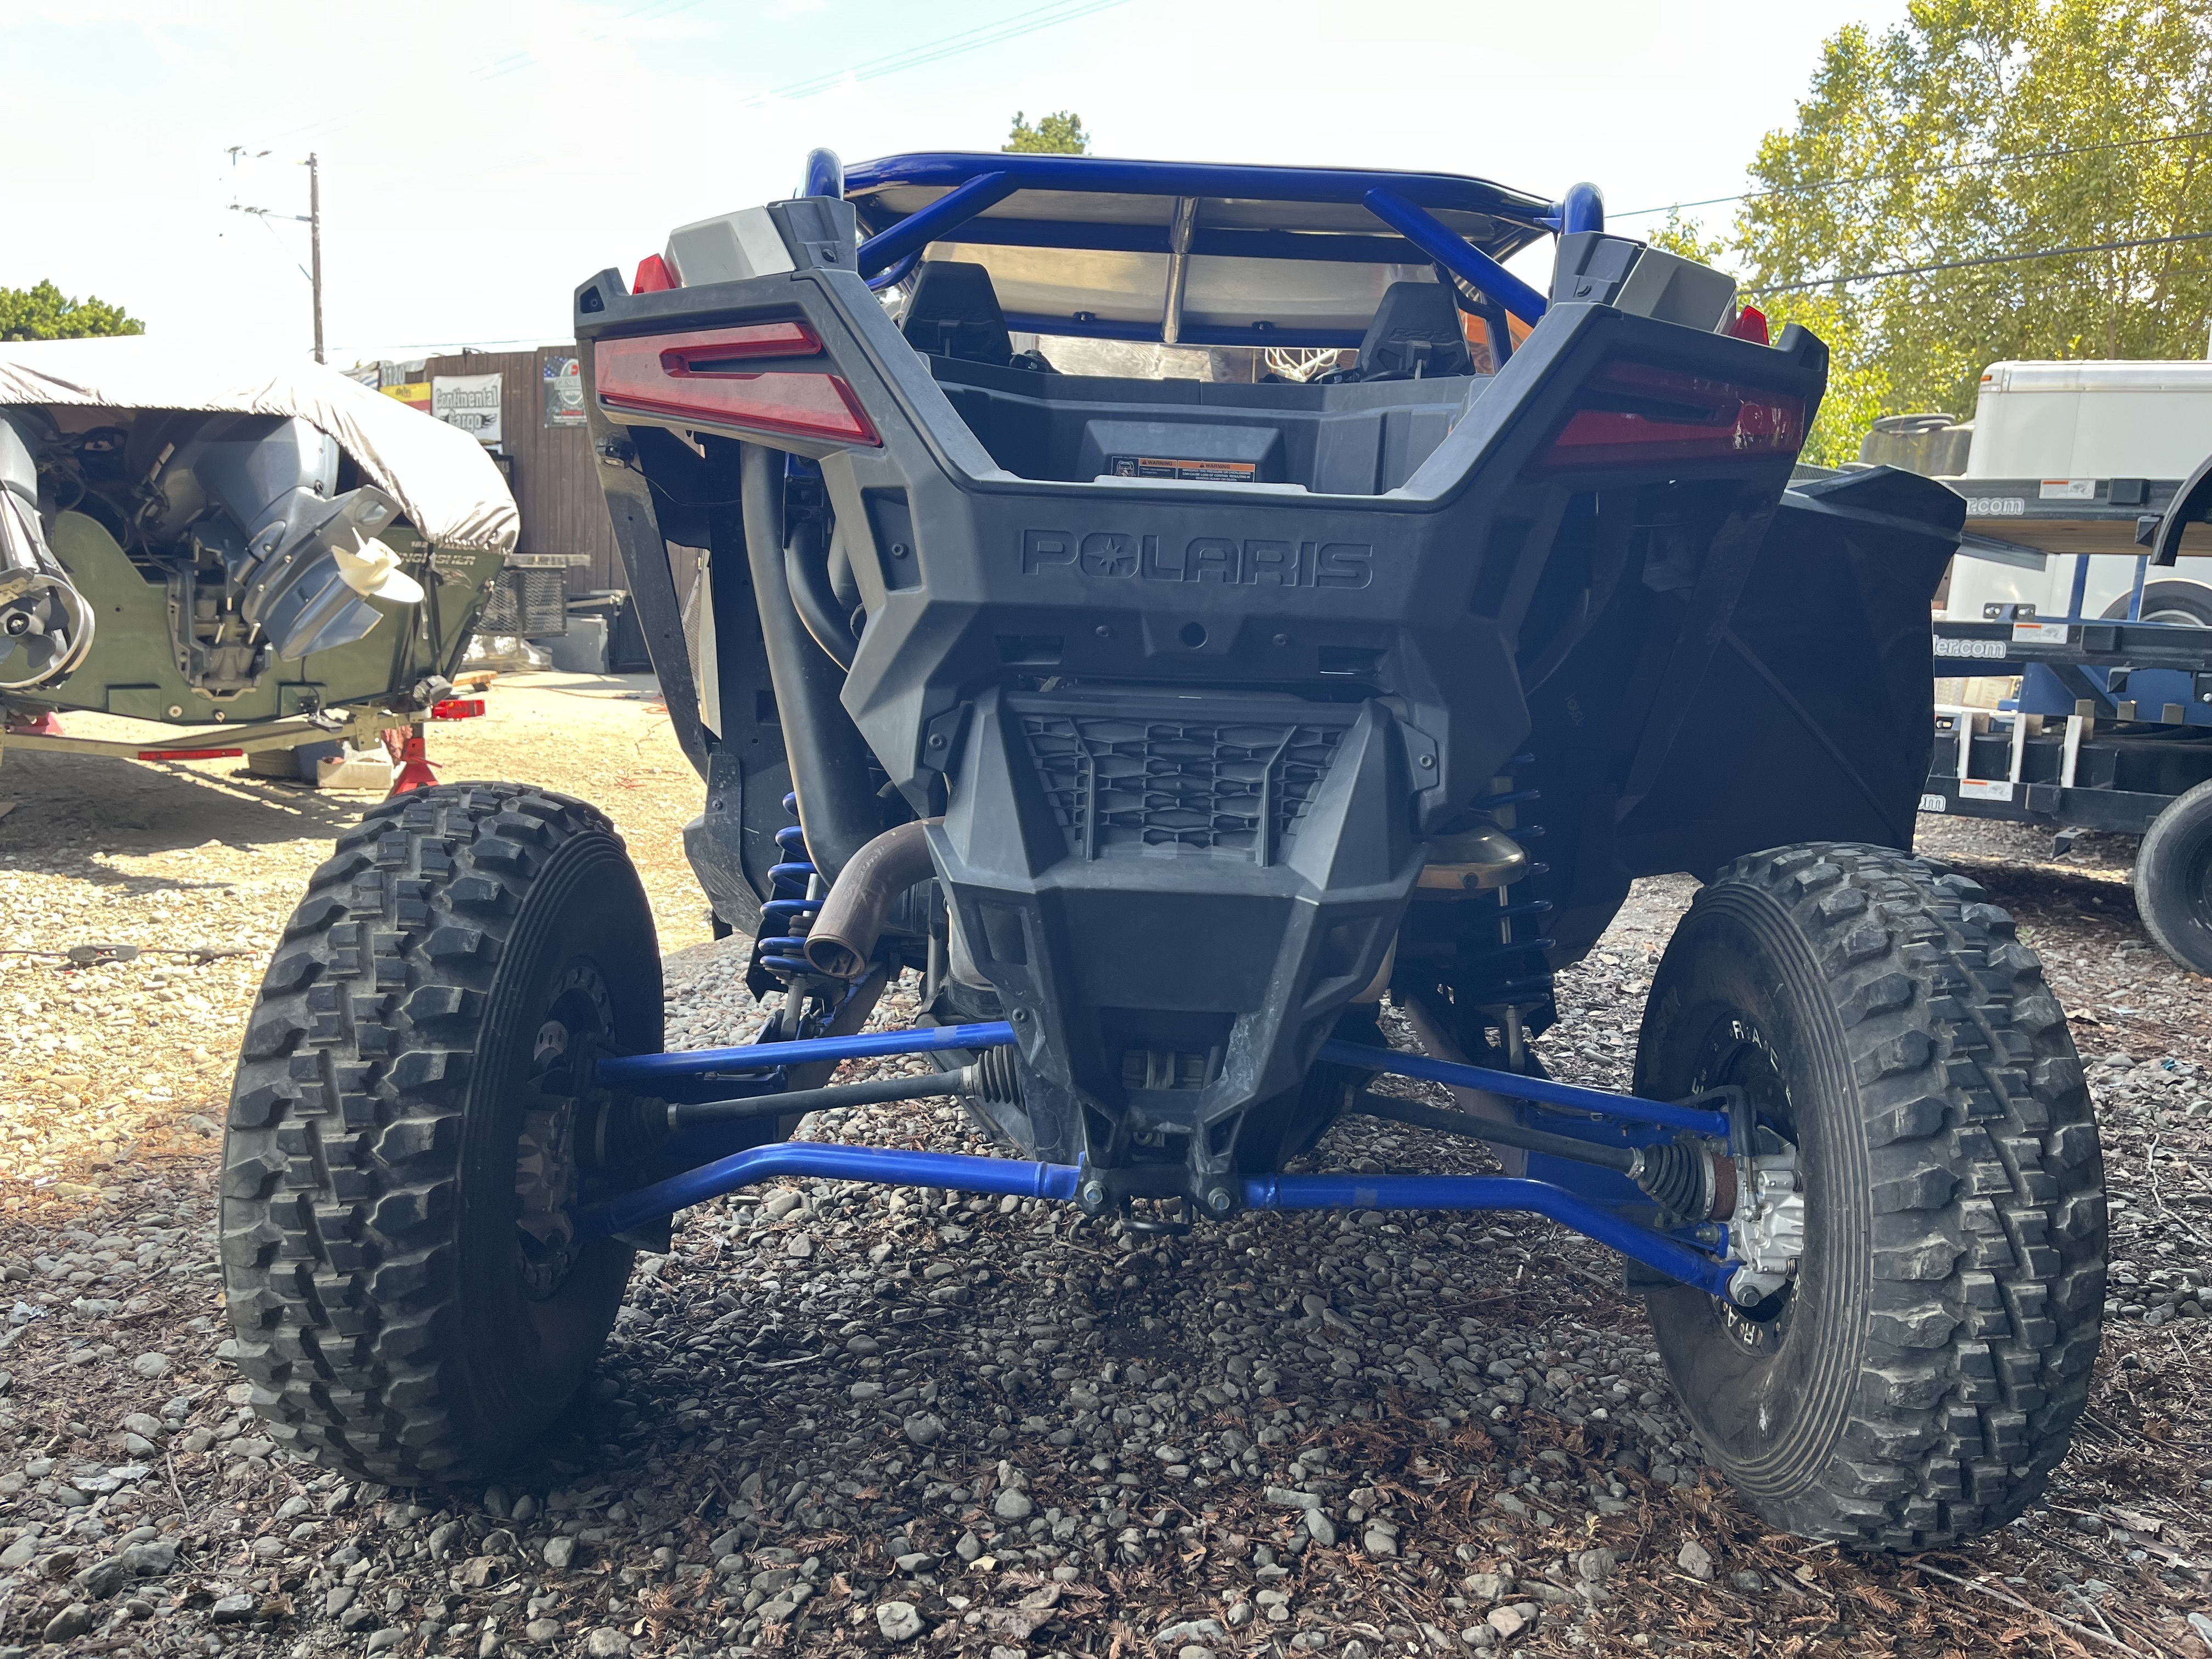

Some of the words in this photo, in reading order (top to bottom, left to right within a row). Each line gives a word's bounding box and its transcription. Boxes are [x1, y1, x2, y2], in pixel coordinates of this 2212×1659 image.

[436, 385, 499, 410] Continental
[448, 407, 483, 435] Cargo
[1023, 529, 1373, 589] POLARIS
